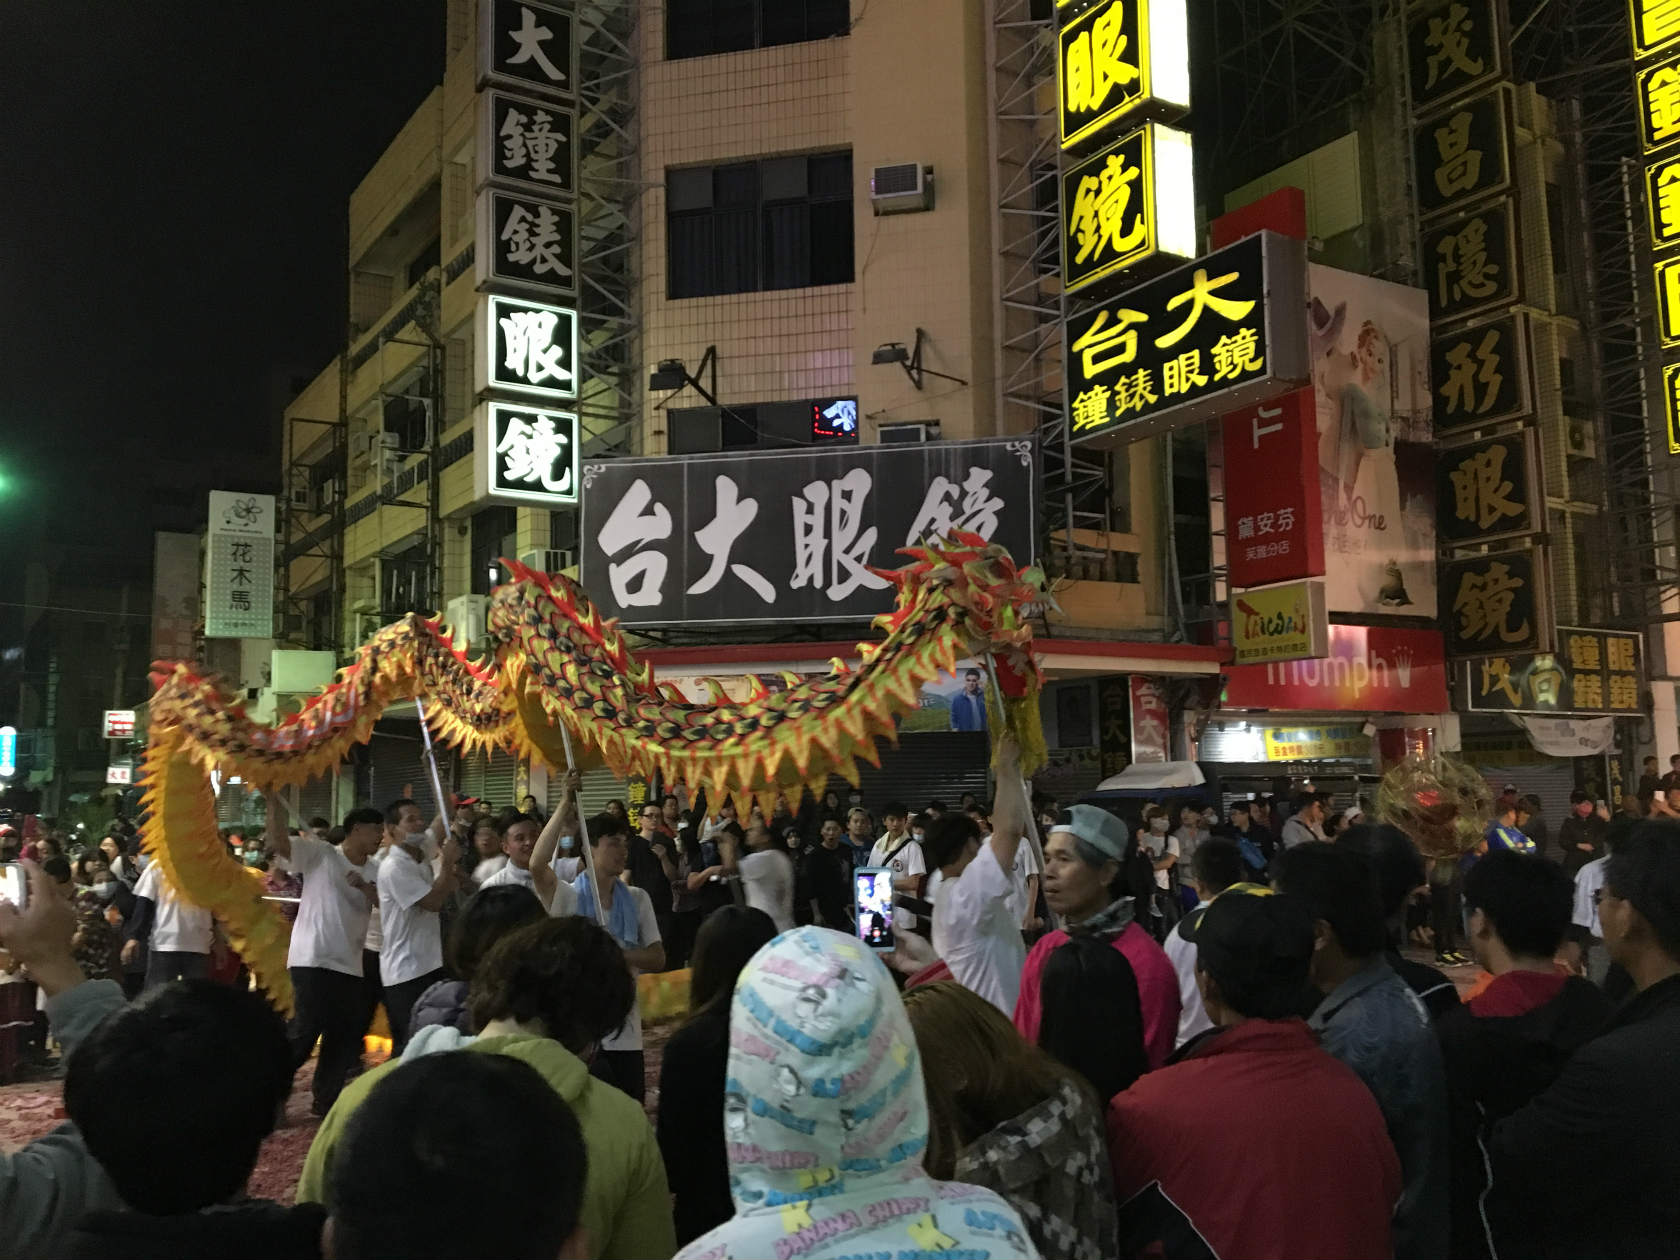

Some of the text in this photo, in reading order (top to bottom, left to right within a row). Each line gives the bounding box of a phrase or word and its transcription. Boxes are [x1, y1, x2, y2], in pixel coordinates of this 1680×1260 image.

[1072, 268, 1257, 382] 台大
[1071, 328, 1265, 433] 鐘錶眼鏡
[1351, 496, 1388, 531] One
[229, 542, 253, 611] 花木馬
